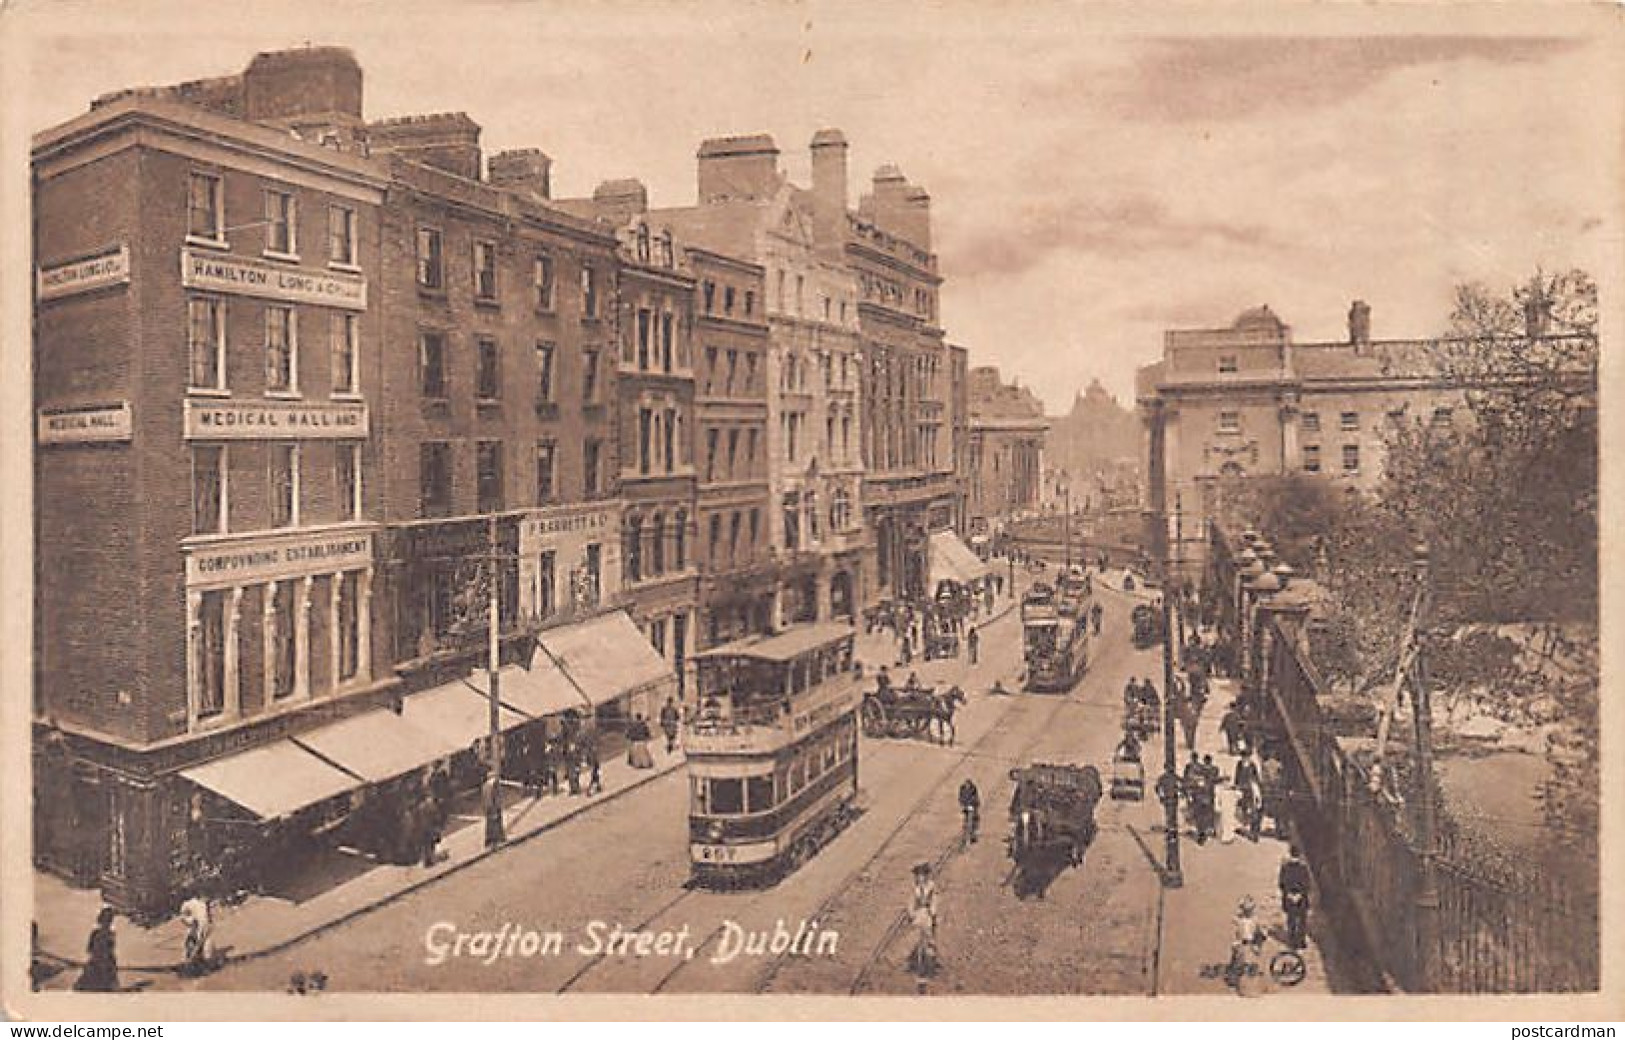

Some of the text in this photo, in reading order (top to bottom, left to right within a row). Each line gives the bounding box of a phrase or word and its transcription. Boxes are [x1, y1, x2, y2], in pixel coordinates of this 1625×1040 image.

[195, 263, 266, 284] HAMILTON
[202, 412, 278, 426] MEDICAL
[288, 412, 329, 426] HALL
[286, 539, 367, 562] ESTABLISHMENT
